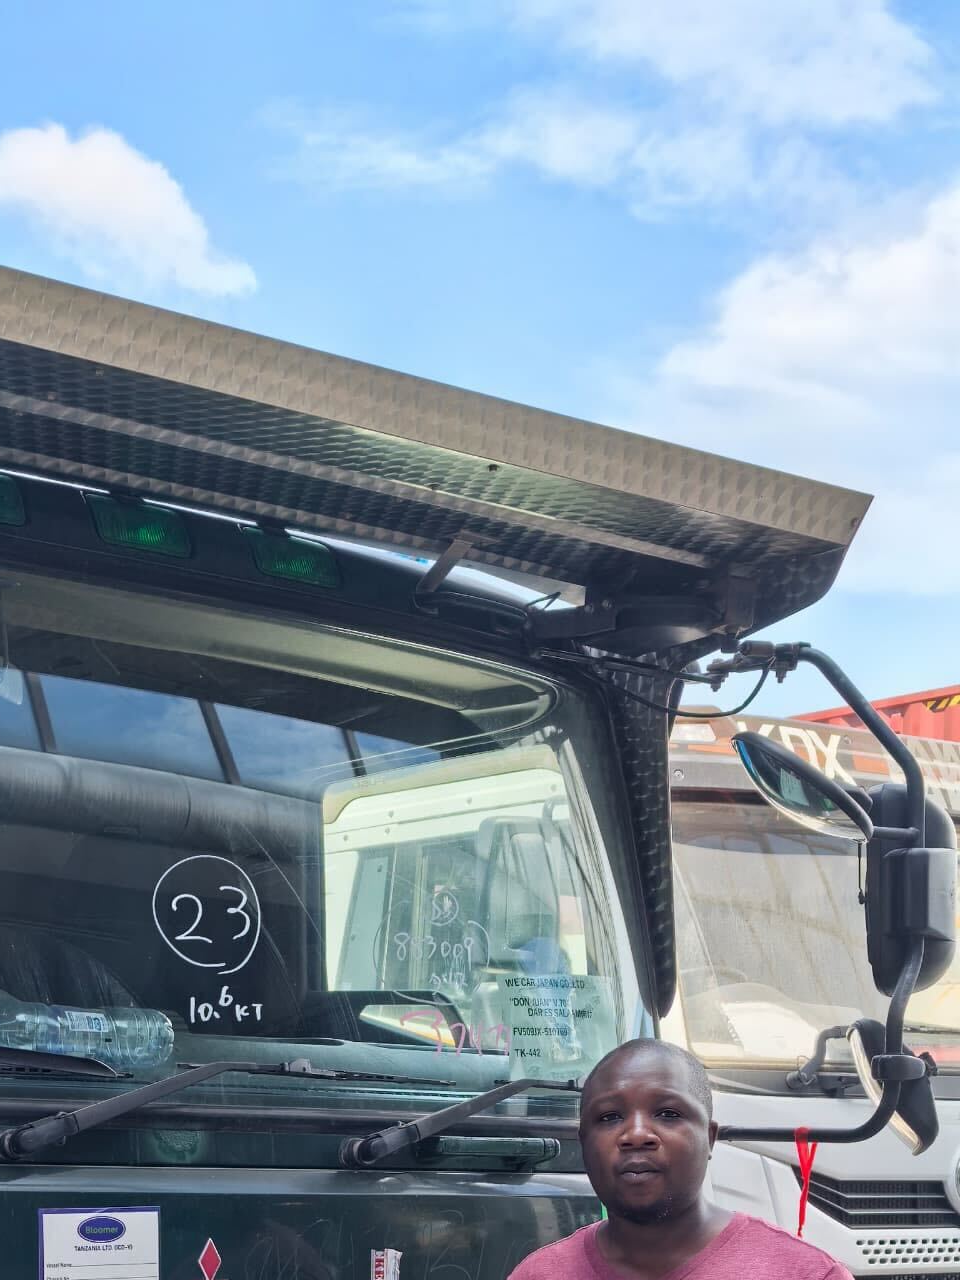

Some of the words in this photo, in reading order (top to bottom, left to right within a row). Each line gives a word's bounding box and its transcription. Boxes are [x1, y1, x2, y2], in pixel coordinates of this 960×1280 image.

[171, 885, 251, 944] 23
[505, 978, 519, 987] WE
[520, 978, 535, 987] CAR
[527, 1007, 543, 1017] DAR
[514, 1048, 541, 1057] TK-442
[85, 1225, 119, 1234] Bloomer
